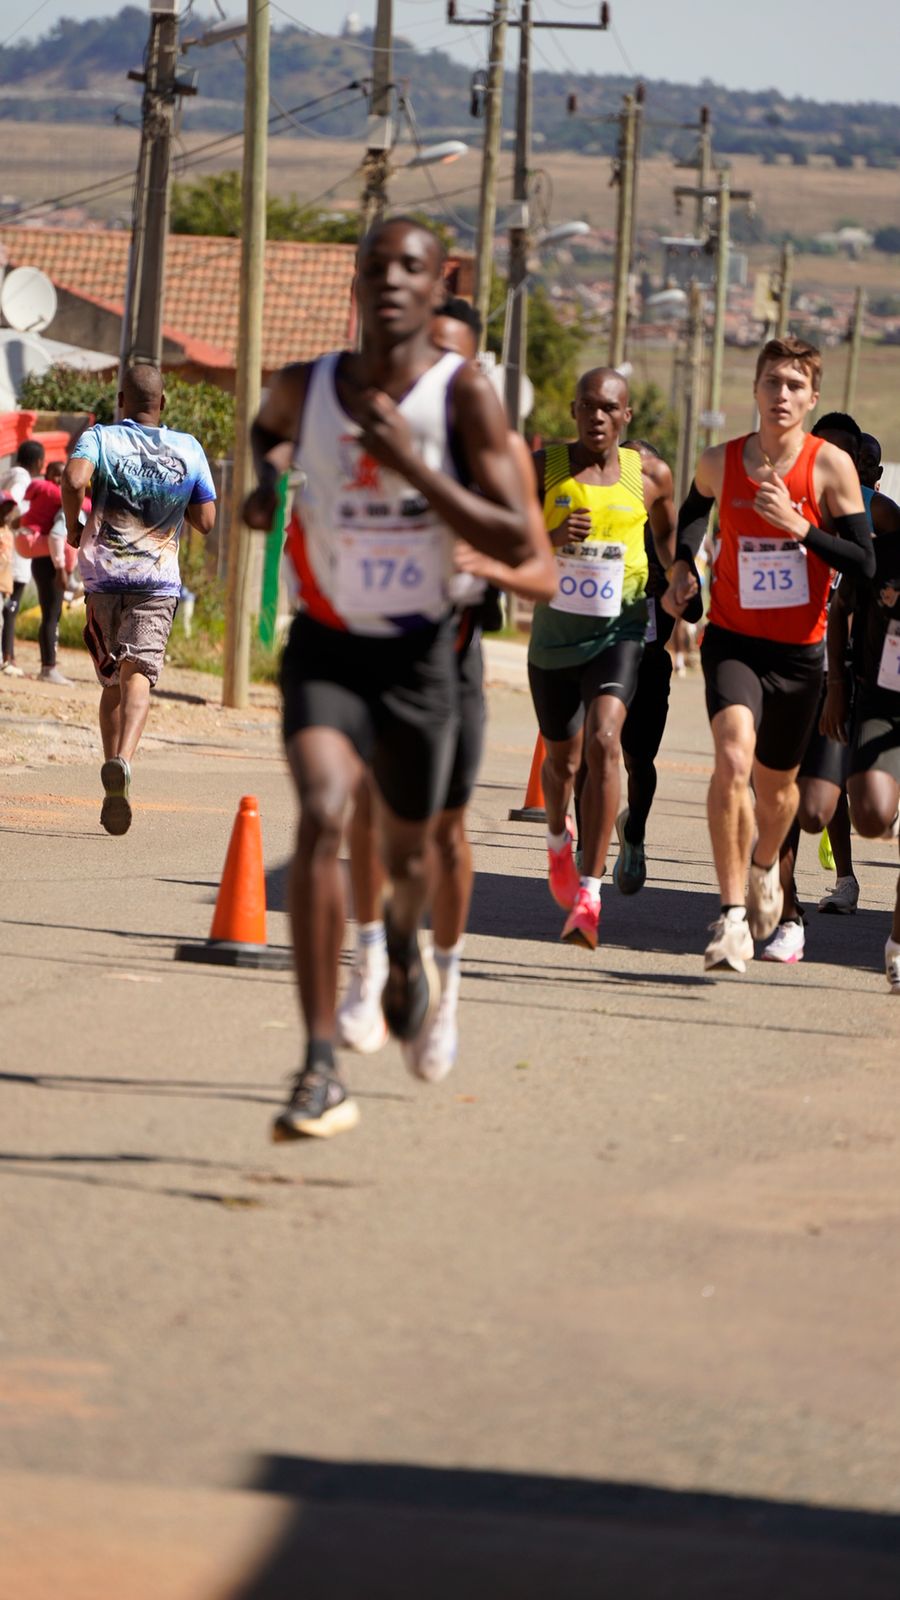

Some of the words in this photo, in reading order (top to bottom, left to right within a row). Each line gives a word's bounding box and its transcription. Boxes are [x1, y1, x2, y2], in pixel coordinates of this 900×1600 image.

[121, 456, 168, 485] Fishing
[361, 558, 424, 590] 176
[752, 569, 793, 591] 213
[560, 576, 614, 599] 006
